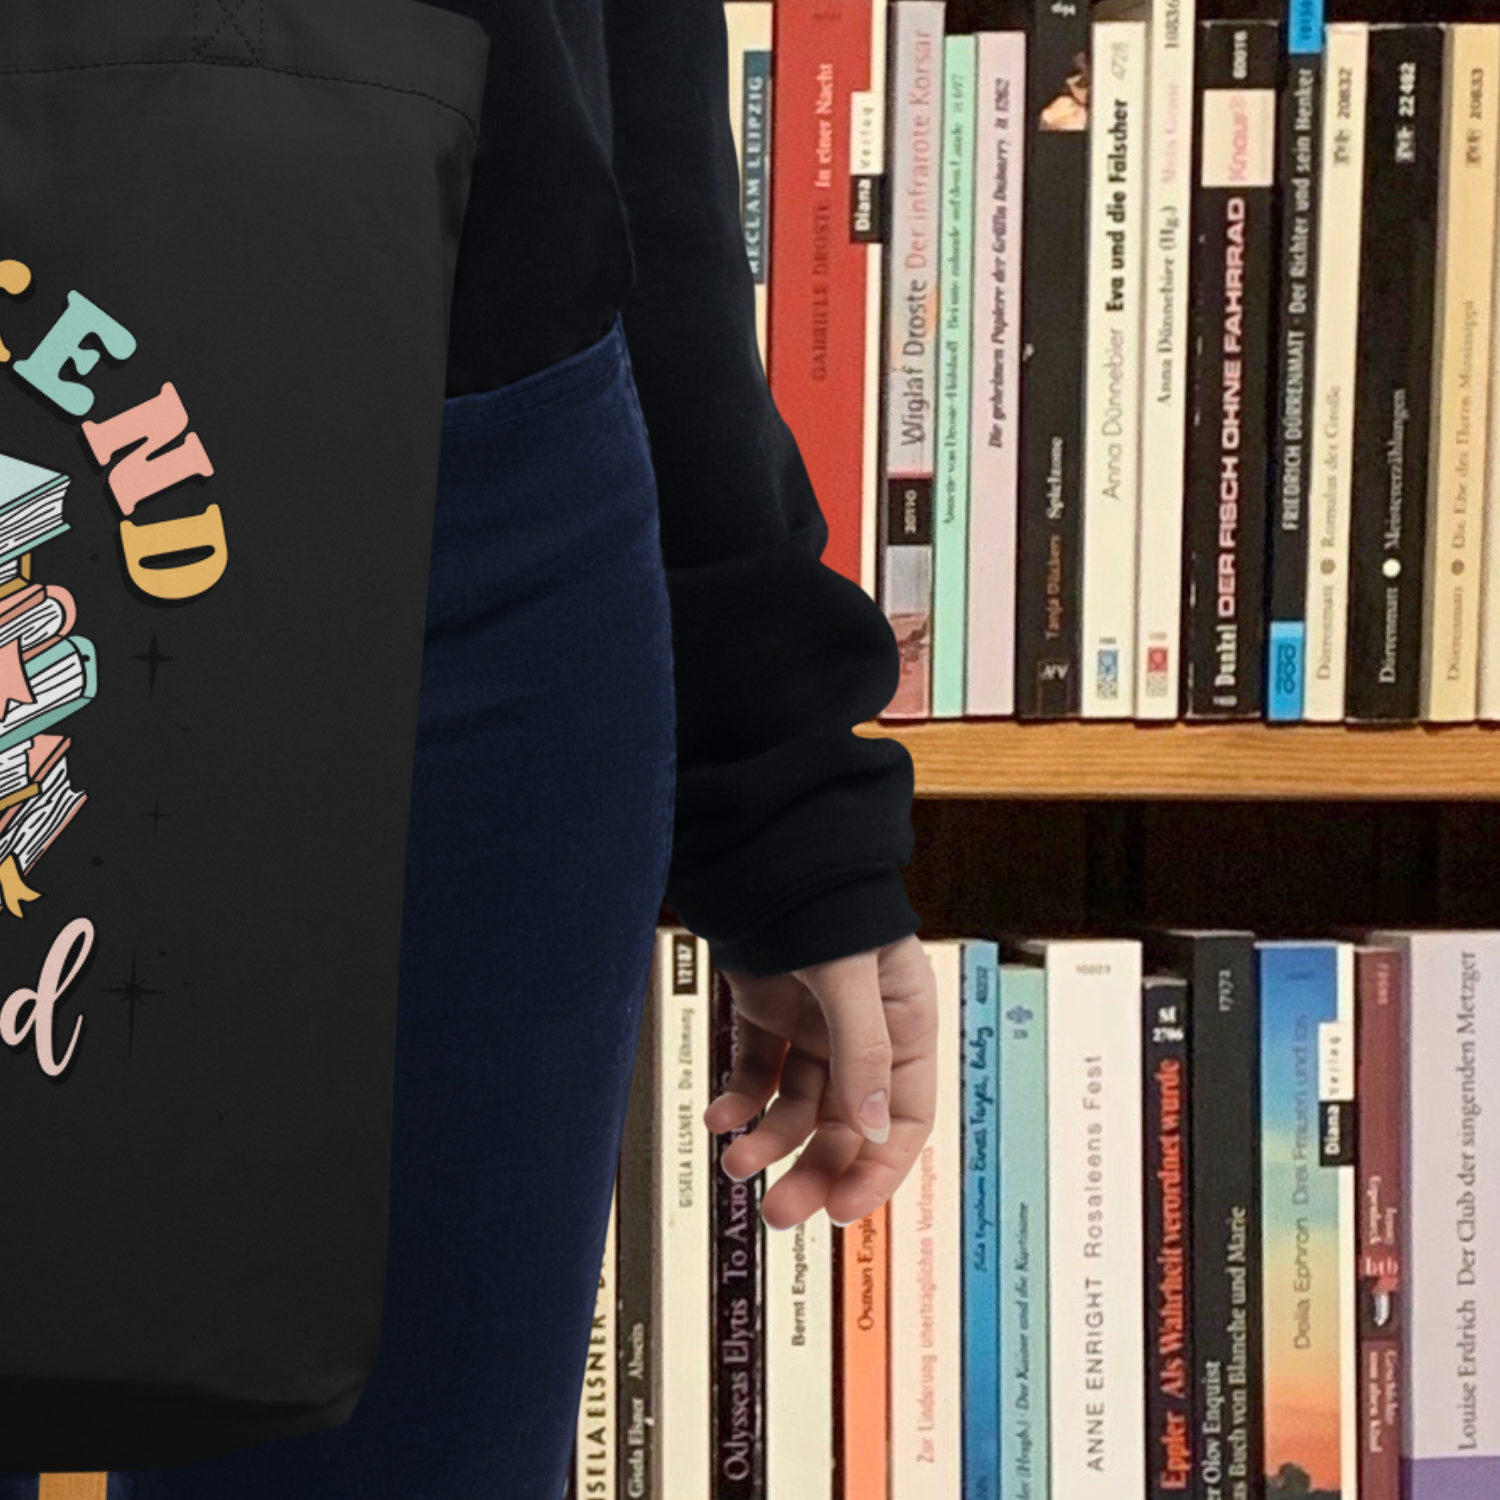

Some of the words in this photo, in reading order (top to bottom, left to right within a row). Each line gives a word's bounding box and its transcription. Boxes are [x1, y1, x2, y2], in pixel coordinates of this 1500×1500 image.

[816, 64, 832, 113] Nacht
[1295, 69, 1313, 130] Henker
[747, 77, 762, 168] LEIPZIG
[817, 120, 832, 163] einer
[1108, 99, 1127, 183] Fälscher
[815, 170, 830, 187] In
[1297, 137, 1310, 172] sein
[856, 179, 870, 230] Diana
[1107, 192, 1126, 223] die
[1292, 178, 1310, 211] und
[1107, 231, 1125, 265] und
[1224, 198, 1244, 352] FAHRRAD
[1290, 218, 1308, 277] Richter
[902, 280, 926, 356] Droste
[1106, 270, 1125, 312] Eva
[1289, 284, 1306, 313] Der
[902, 366, 929, 445] Wiglaf
[1222, 361, 1240, 449] OHNE
[1283, 331, 1304, 440] DÜRRENMATT
[1219, 457, 1238, 547] FISCH
[1282, 446, 1301, 529] FRIEDRICH
[1218, 554, 1235, 617] DER
[1215, 625, 1236, 686] Dunkel
[1456, 952, 1479, 1034] Metzger
[1083, 1056, 1101, 1110] Fest
[1156, 1060, 1179, 1130] wurde
[1456, 1041, 1481, 1146] singenden
[1325, 1105, 1339, 1154] Diana
[1084, 1123, 1102, 1258] Rosaleens
[1157, 1135, 1181, 1243] verordnet
[1457, 1153, 1475, 1186] der
[1228, 1207, 1245, 1261] Marie
[1456, 1191, 1475, 1242] Club
[723, 1248, 746, 1279] To
[1226, 1267, 1245, 1304] und
[1457, 1249, 1475, 1285] Der
[723, 1298, 749, 1363] Elytis
[858, 1268, 873, 1331] Osman
[1158, 1248, 1182, 1354] Wahrheit
[1085, 1278, 1103, 1390] ENRIGHT
[1227, 1309, 1246, 1384] Blanche
[1457, 1300, 1476, 1377] Erdrich
[1161, 1359, 1183, 1397] Als
[1202, 1361, 1225, 1433] Enquist
[1233, 1390, 1246, 1424] von
[724, 1372, 751, 1479] Odysseas
[1086, 1404, 1104, 1471] ANNE
[1458, 1383, 1477, 1450] Louise
[1161, 1412, 1191, 1488] Eppler
[1202, 1439, 1221, 1483] Olov
[1228, 1429, 1246, 1476] Buch
